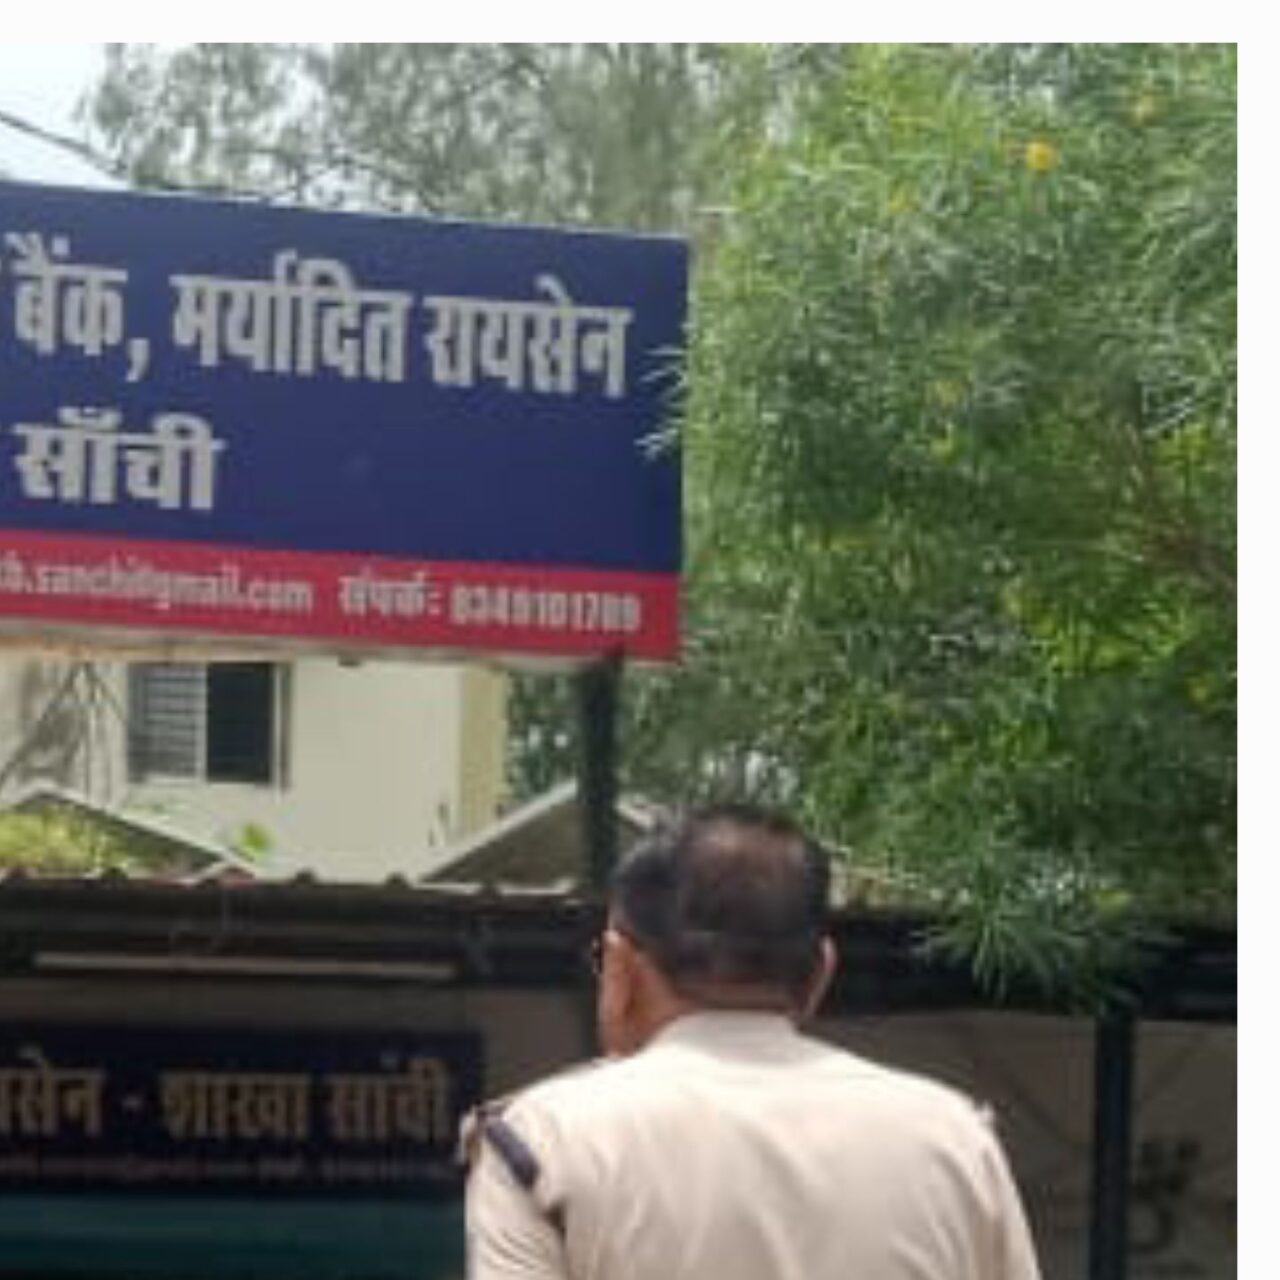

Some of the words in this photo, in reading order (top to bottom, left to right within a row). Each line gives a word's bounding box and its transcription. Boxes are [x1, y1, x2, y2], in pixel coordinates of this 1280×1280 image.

[5, 230, 151, 382] बैंक,
[170, 249, 412, 384] मर्यादित
[423, 275, 634, 397] रायसेन
[157, 1067, 311, 1140] शाखा
[326, 1049, 455, 1142] सांची
